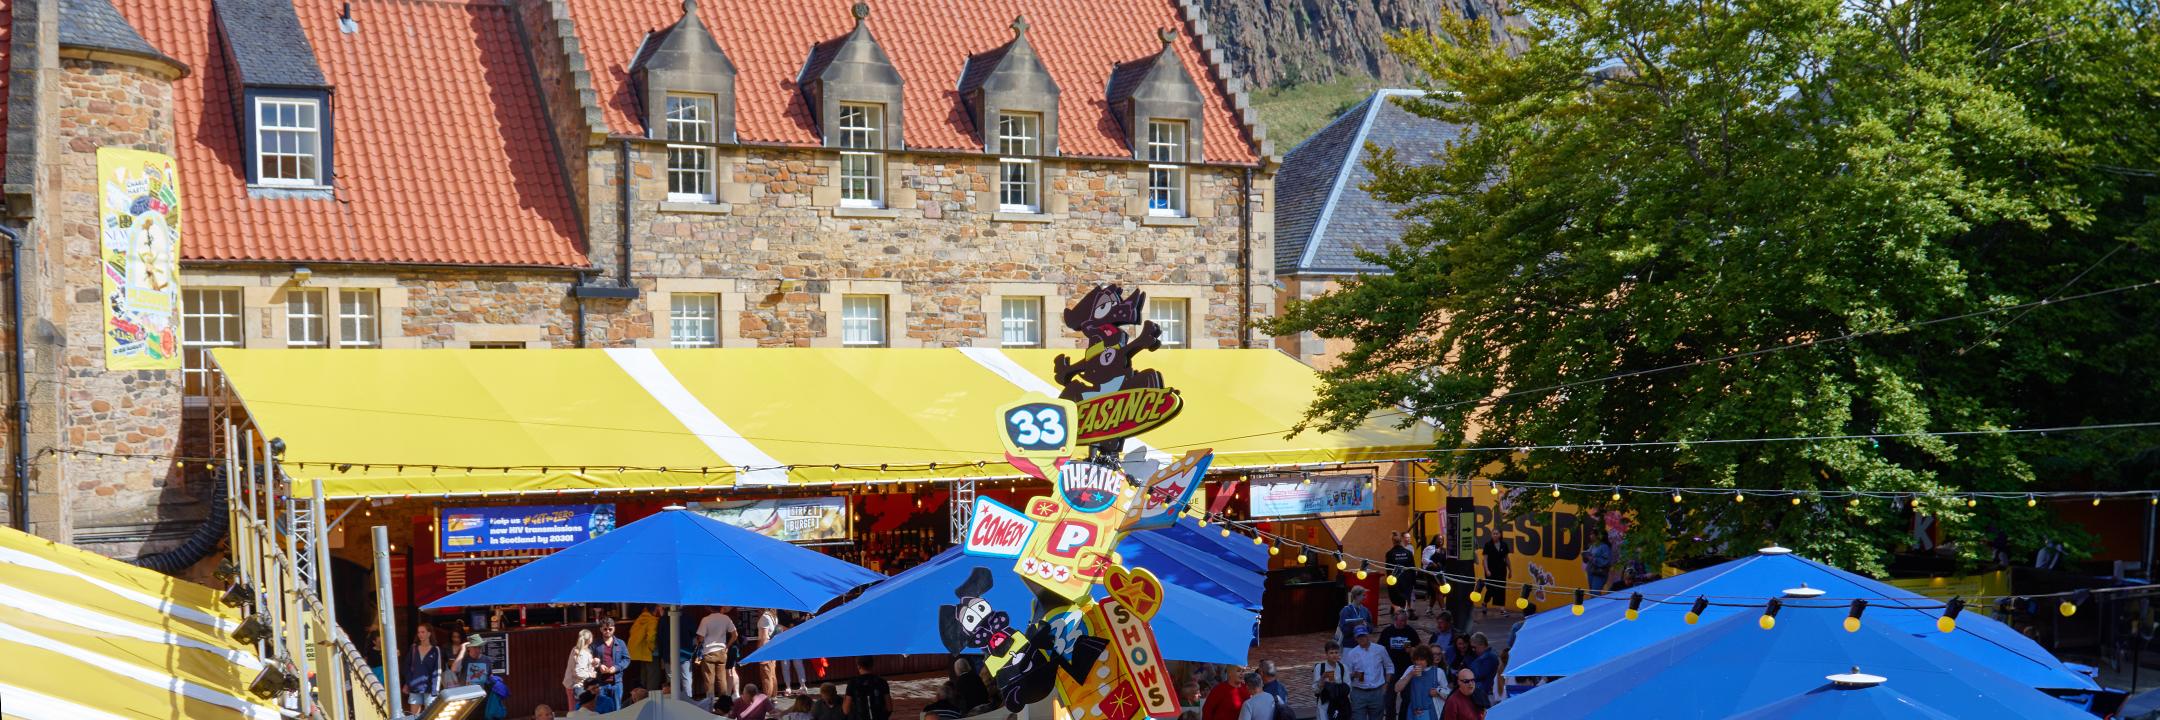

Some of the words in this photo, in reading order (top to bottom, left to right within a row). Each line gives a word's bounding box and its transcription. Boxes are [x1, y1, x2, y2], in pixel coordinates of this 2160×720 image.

[1104, 352, 1112, 363] P
[1010, 408, 1065, 445] 33
[1060, 463, 1125, 495] THEATRE
[509, 526, 524, 534] HIV
[525, 525, 582, 534] transmissions
[790, 518, 815, 530] BURGER
[971, 513, 1029, 547] COMEDY
[1056, 524, 1090, 552] P
[499, 536, 537, 544] Scotland
[537, 536, 549, 546] by
[549, 535, 574, 543] 2030!
[1113, 604, 1165, 707] SHOWS
